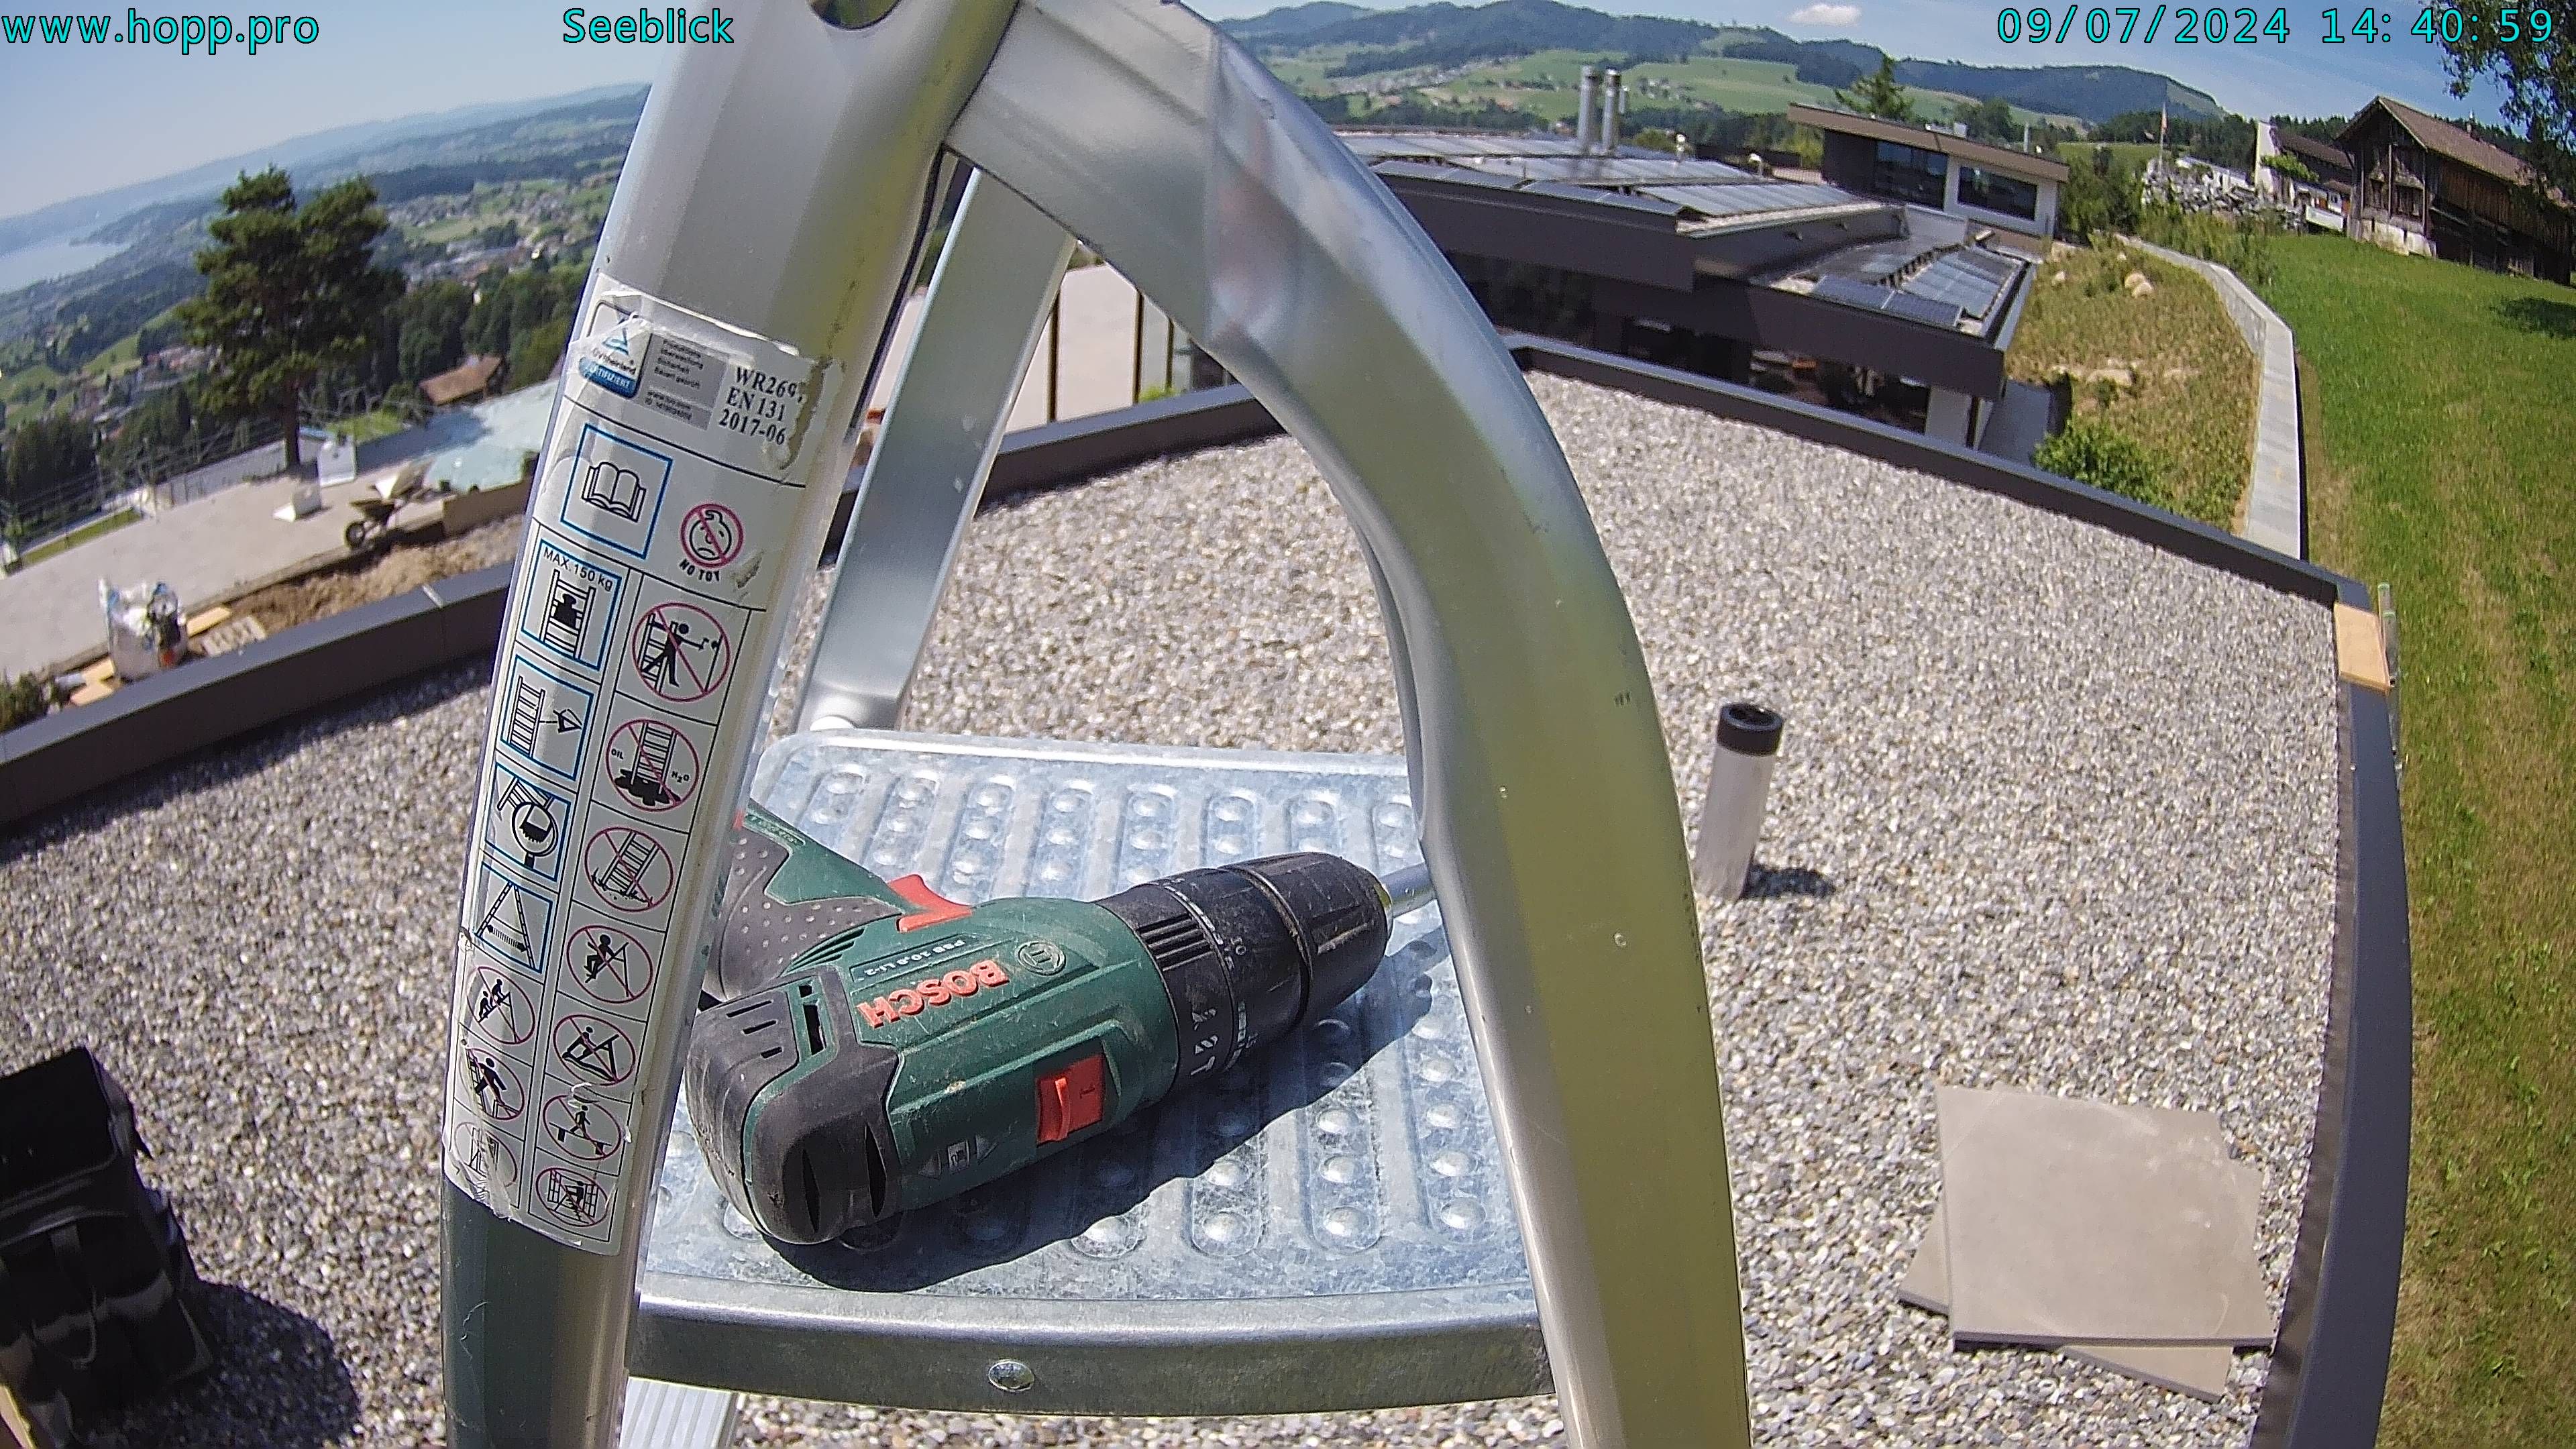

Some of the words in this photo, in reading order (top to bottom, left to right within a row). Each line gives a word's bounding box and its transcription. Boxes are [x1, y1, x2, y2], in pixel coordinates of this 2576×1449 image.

[727, 386, 755, 411] EN
[757, 398, 786, 422] 131
[719, 409, 787, 445] 2017-06
[598, 574, 613, 592] kg
[679, 558, 696, 576] NO
[698, 569, 720, 582] TOY
[611, 749, 624, 760] OIL
[856, 959, 1010, 1029] BOSCH
